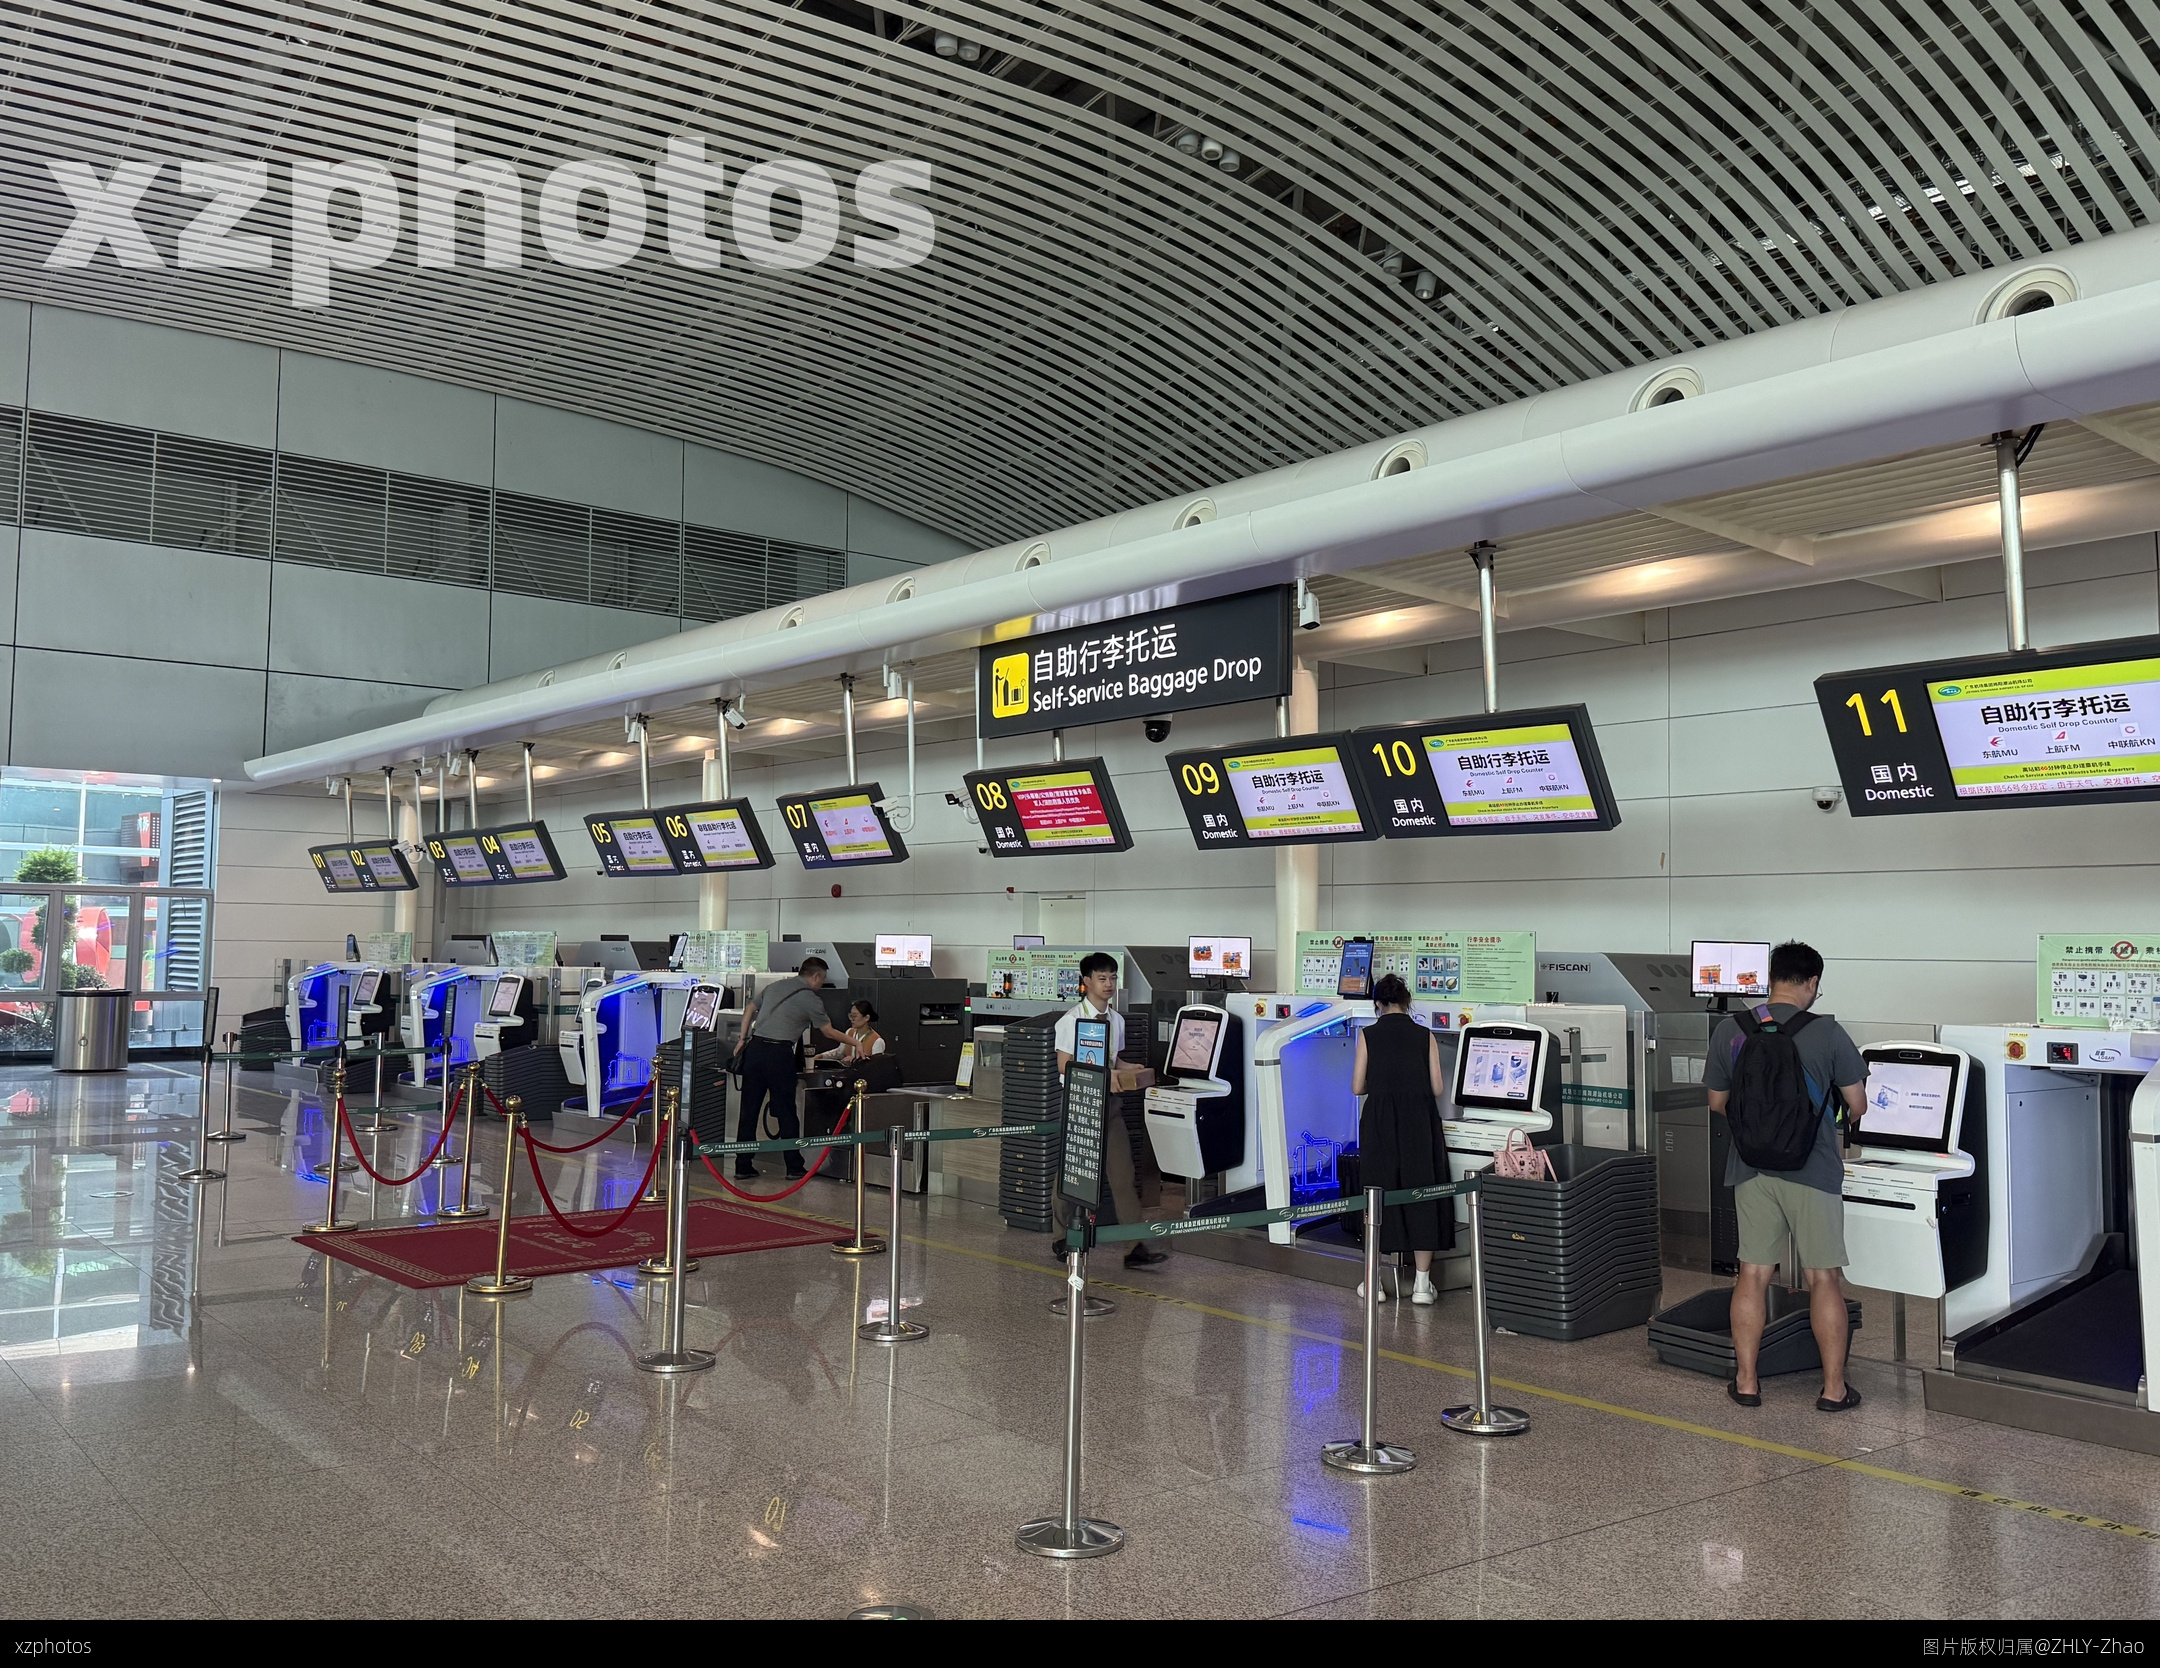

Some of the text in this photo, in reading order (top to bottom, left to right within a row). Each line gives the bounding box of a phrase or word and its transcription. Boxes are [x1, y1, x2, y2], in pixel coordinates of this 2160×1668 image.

[1033, 623, 1178, 684] 自助行李托运
[1033, 655, 1263, 712] Self-Service Baggage Drop
[1845, 689, 1908, 736] 11
[1980, 693, 2131, 725] 自助行李托运
[1998, 717, 2119, 733] Domestic Self Drop Counter
[1372, 740, 1416, 777] 10
[1982, 738, 2156, 759] 东航MU 上航FM 中联航KN
[1457, 749, 1550, 771] 自助行李托运
[1181, 762, 1220, 796] 09
[1251, 769, 1325, 789] 自助行李托运
[1870, 762, 1918, 785] 国内
[976, 781, 1007, 811] 08
[1864, 784, 1934, 801] Domestic
[1394, 798, 1425, 814] 国内
[666, 815, 688, 838] 06
[786, 804, 807, 829] 07
[1202, 813, 1228, 828] 国内
[1392, 815, 1436, 828] Domestic
[591, 822, 611, 844] 05
[1202, 828, 1238, 840] Domestic
[430, 841, 445, 859] 03
[482, 835, 500, 854] 04
[996, 840, 1023, 849] Domestic
[312, 853, 325, 868] 01
[351, 850, 365, 866] 02
[2066, 946, 2103, 954] 禁止携带
[1549, 963, 1588, 971] FISCAN
